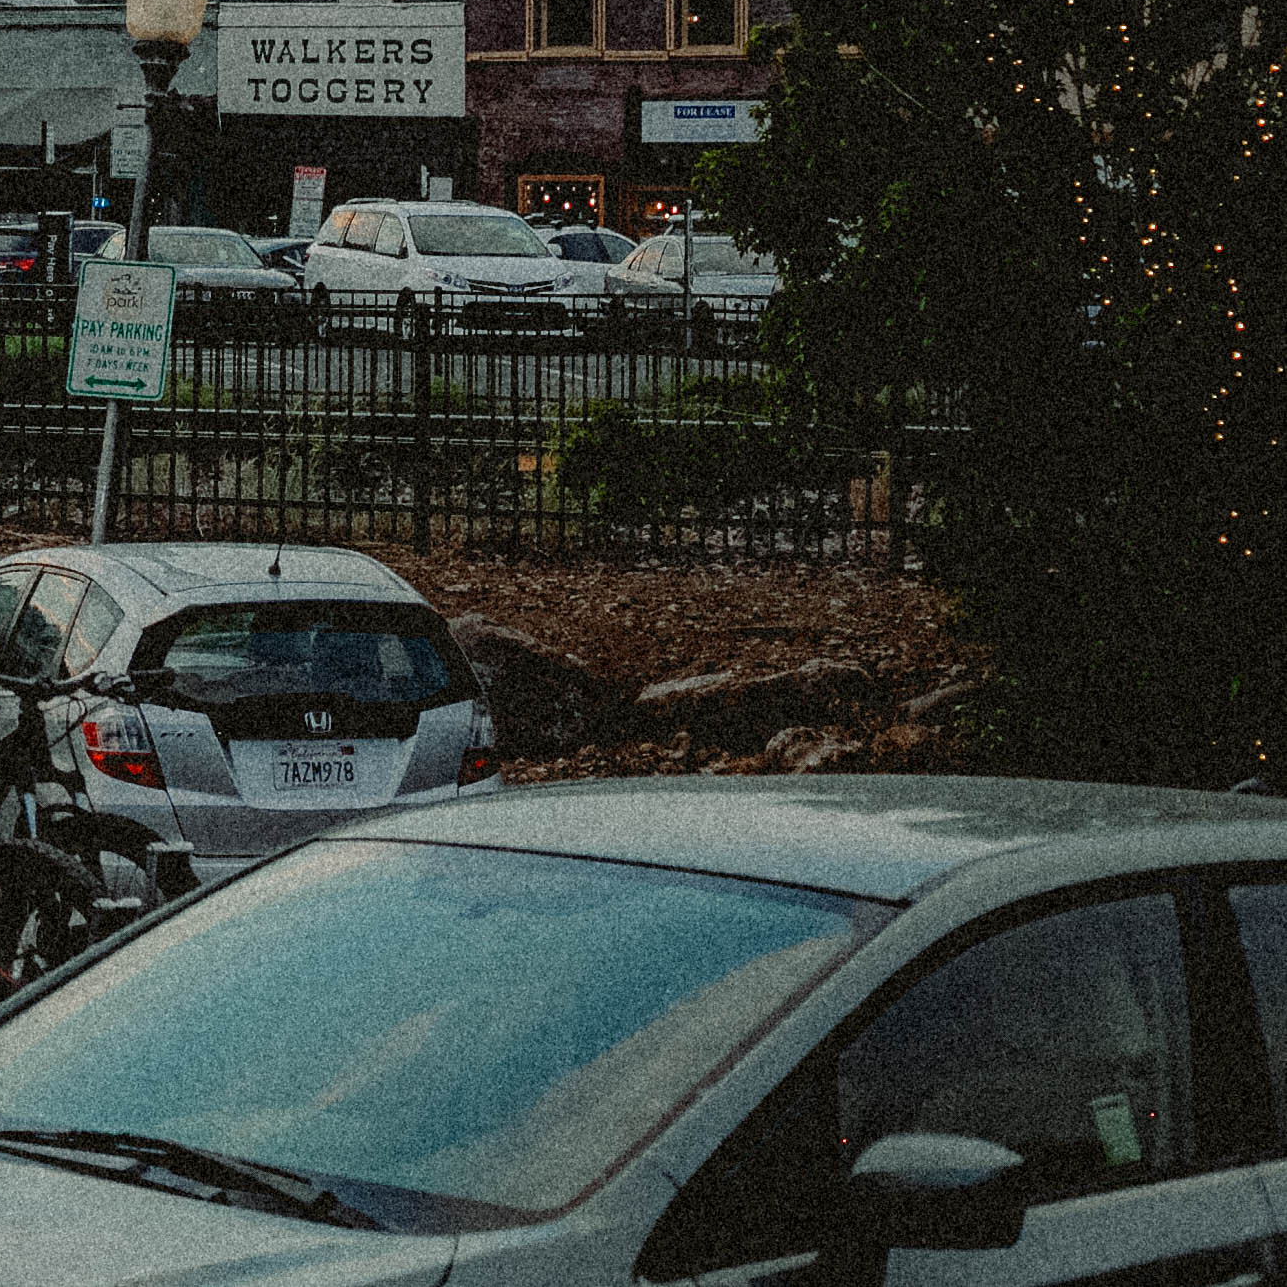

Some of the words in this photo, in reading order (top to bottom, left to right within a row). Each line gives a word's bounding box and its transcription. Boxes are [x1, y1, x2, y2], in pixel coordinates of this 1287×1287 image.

[251, 39, 434, 64] WALKERS
[247, 78, 433, 104] TOGGERY
[676, 106, 698, 117] FOR
[81, 319, 105, 337] PAY
[110, 321, 164, 342] PARKING
[280, 761, 355, 783] 7AZM978
